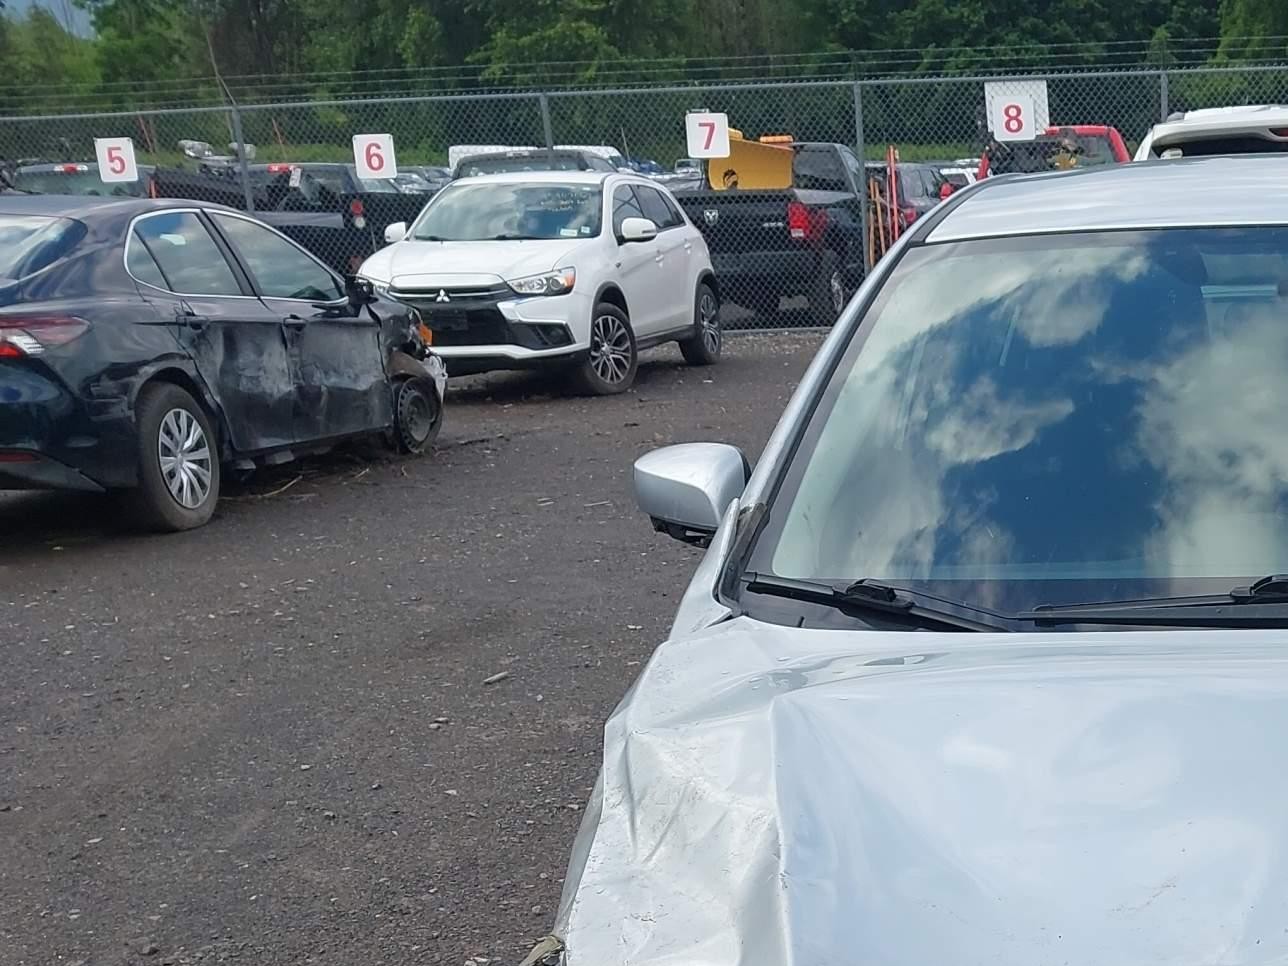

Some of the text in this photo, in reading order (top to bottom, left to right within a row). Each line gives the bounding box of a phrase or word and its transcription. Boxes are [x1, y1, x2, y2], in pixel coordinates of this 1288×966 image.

[1004, 104, 1024, 133] 8
[698, 122, 716, 150] 7
[107, 146, 126, 175] 5
[365, 142, 385, 171] 6
